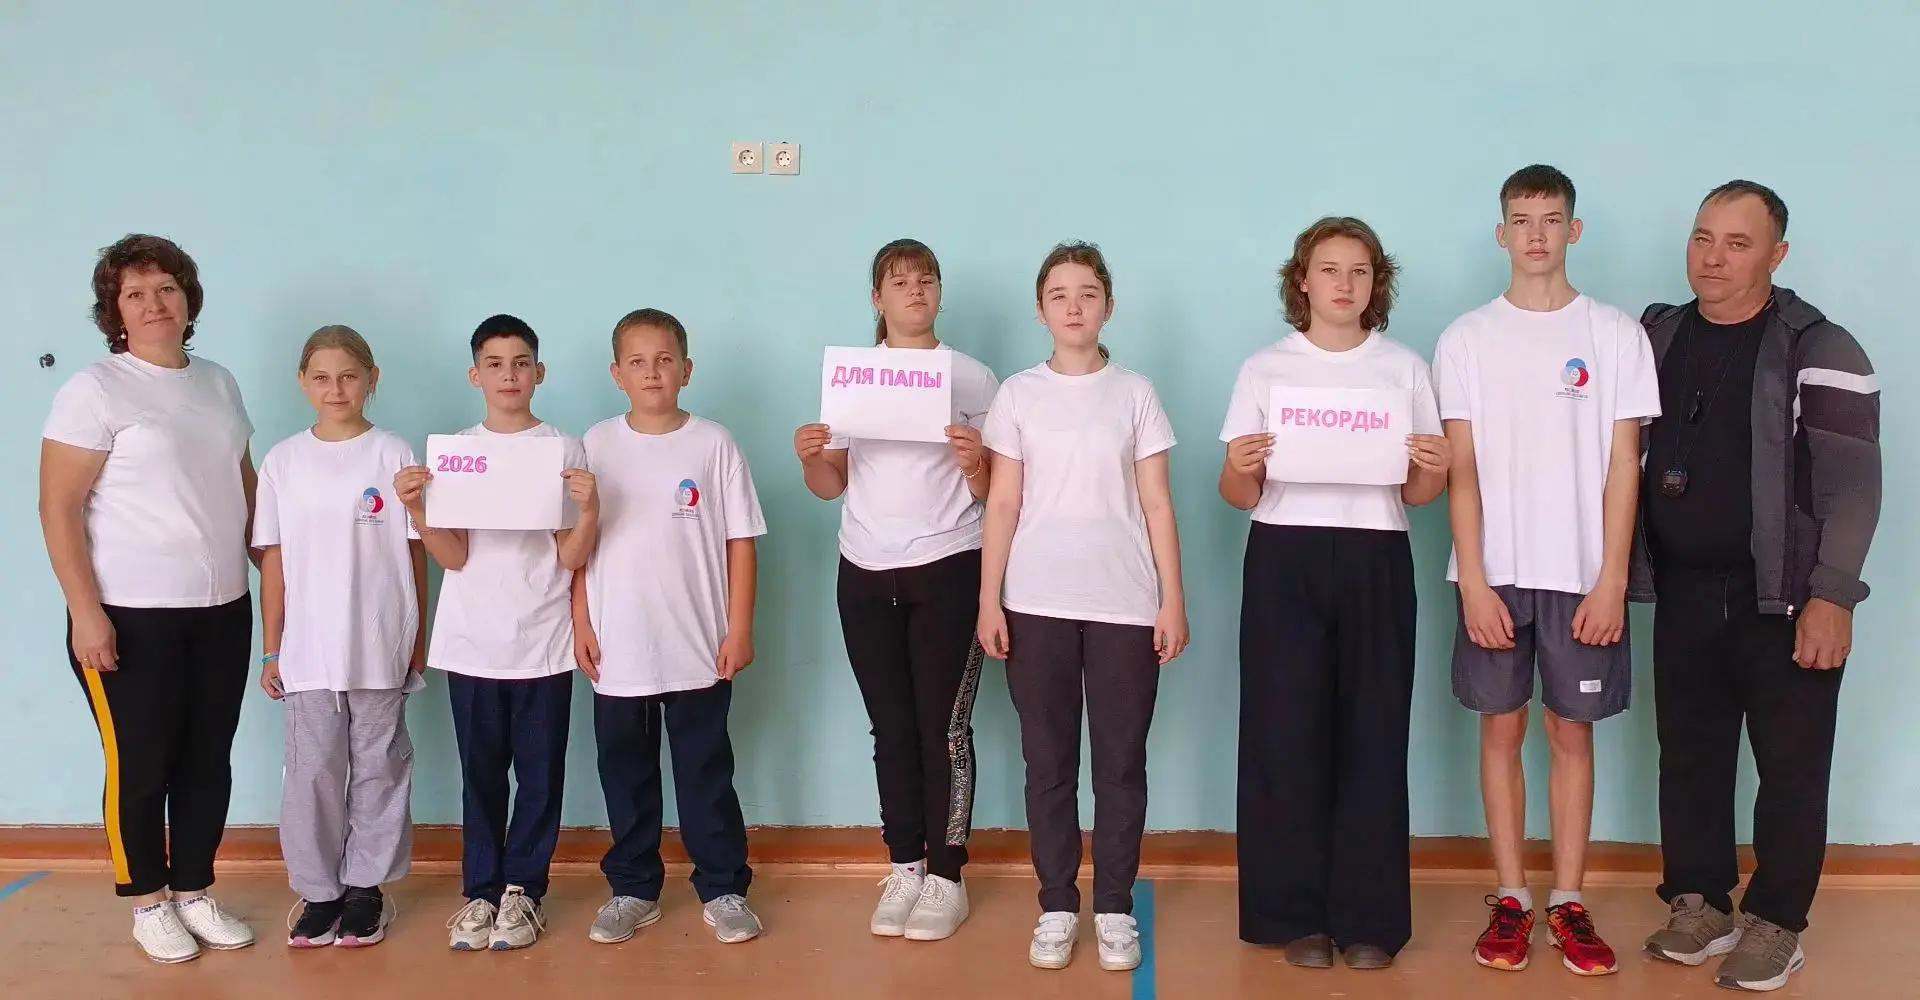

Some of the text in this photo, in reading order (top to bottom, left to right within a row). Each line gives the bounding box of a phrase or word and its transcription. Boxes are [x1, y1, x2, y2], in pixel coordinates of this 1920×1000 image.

[831, 366, 942, 388] ДЛЯ ПАПЫ
[1281, 407, 1389, 432] РЕКОРДЫ
[437, 455, 487, 473] 2026
